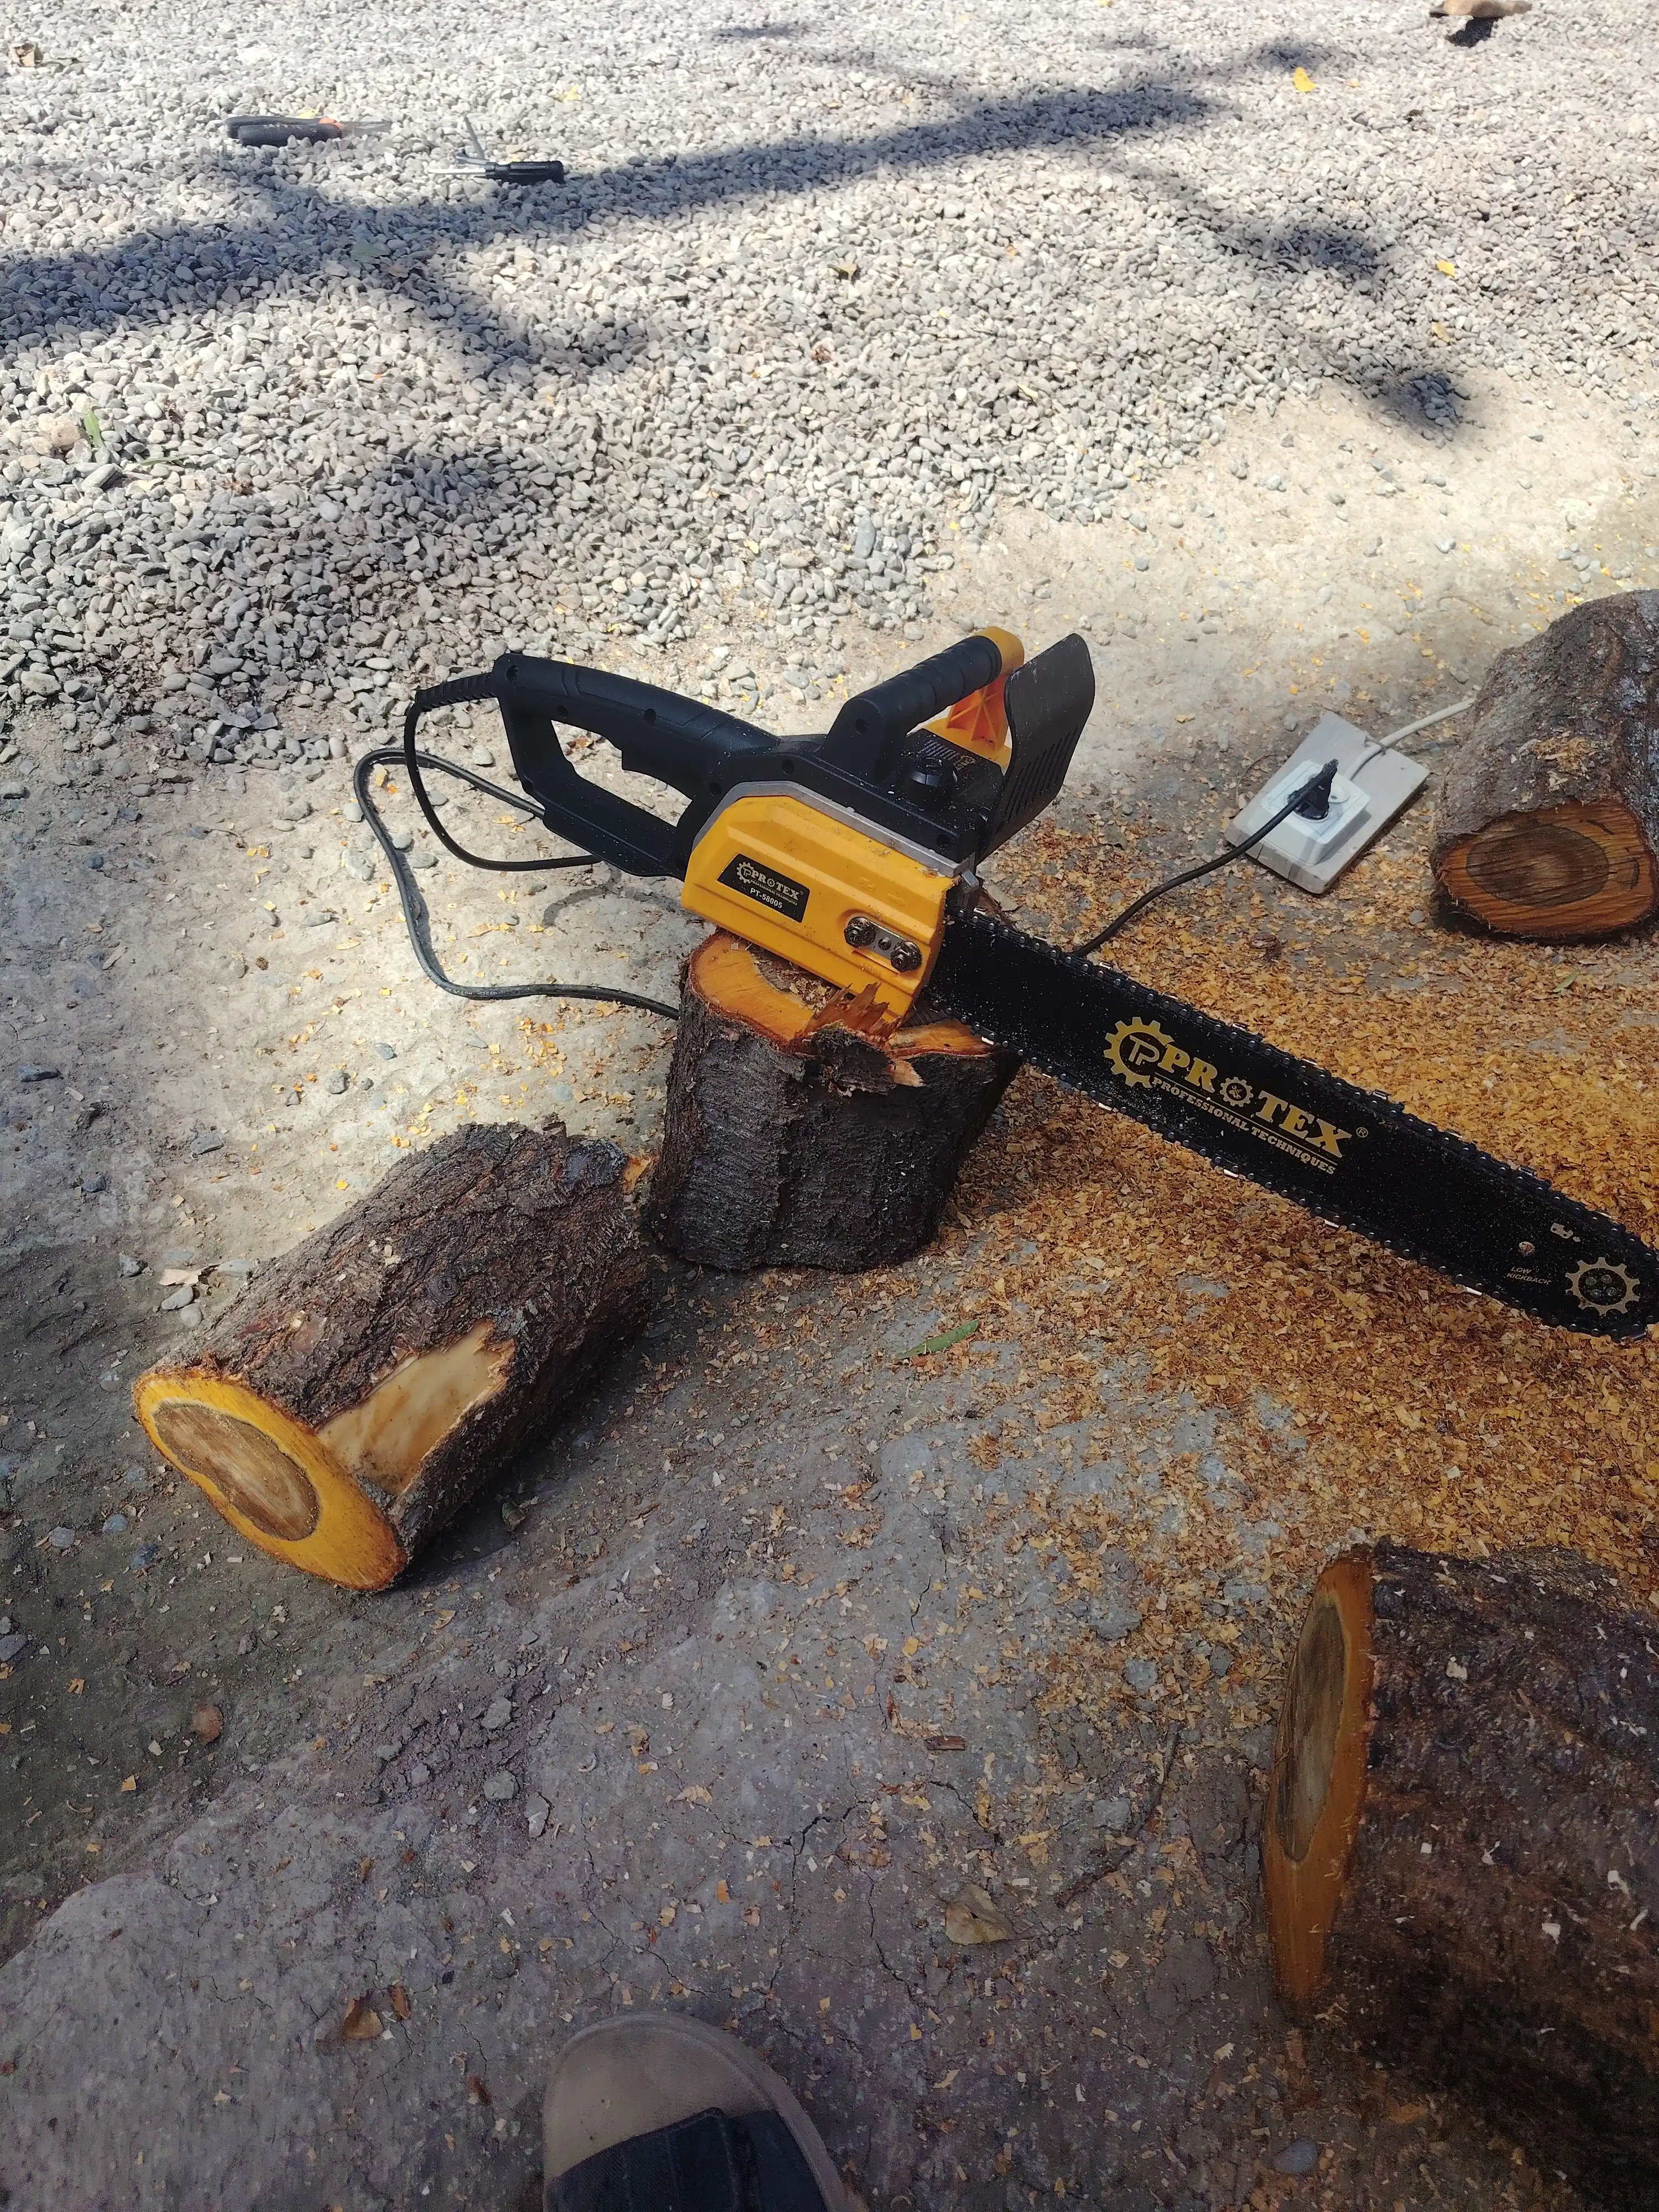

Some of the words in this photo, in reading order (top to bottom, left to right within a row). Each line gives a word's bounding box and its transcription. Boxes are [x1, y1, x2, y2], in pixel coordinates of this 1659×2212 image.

[750, 879, 775, 894] PROFESSIONAL
[750, 888, 783, 909] PT-58005
[1151, 1077, 1249, 1131] PROFESSIONAL
[1251, 1126, 1336, 1175] TECHNIQUES
[1506, 1272, 1551, 1285] KICKBACK
